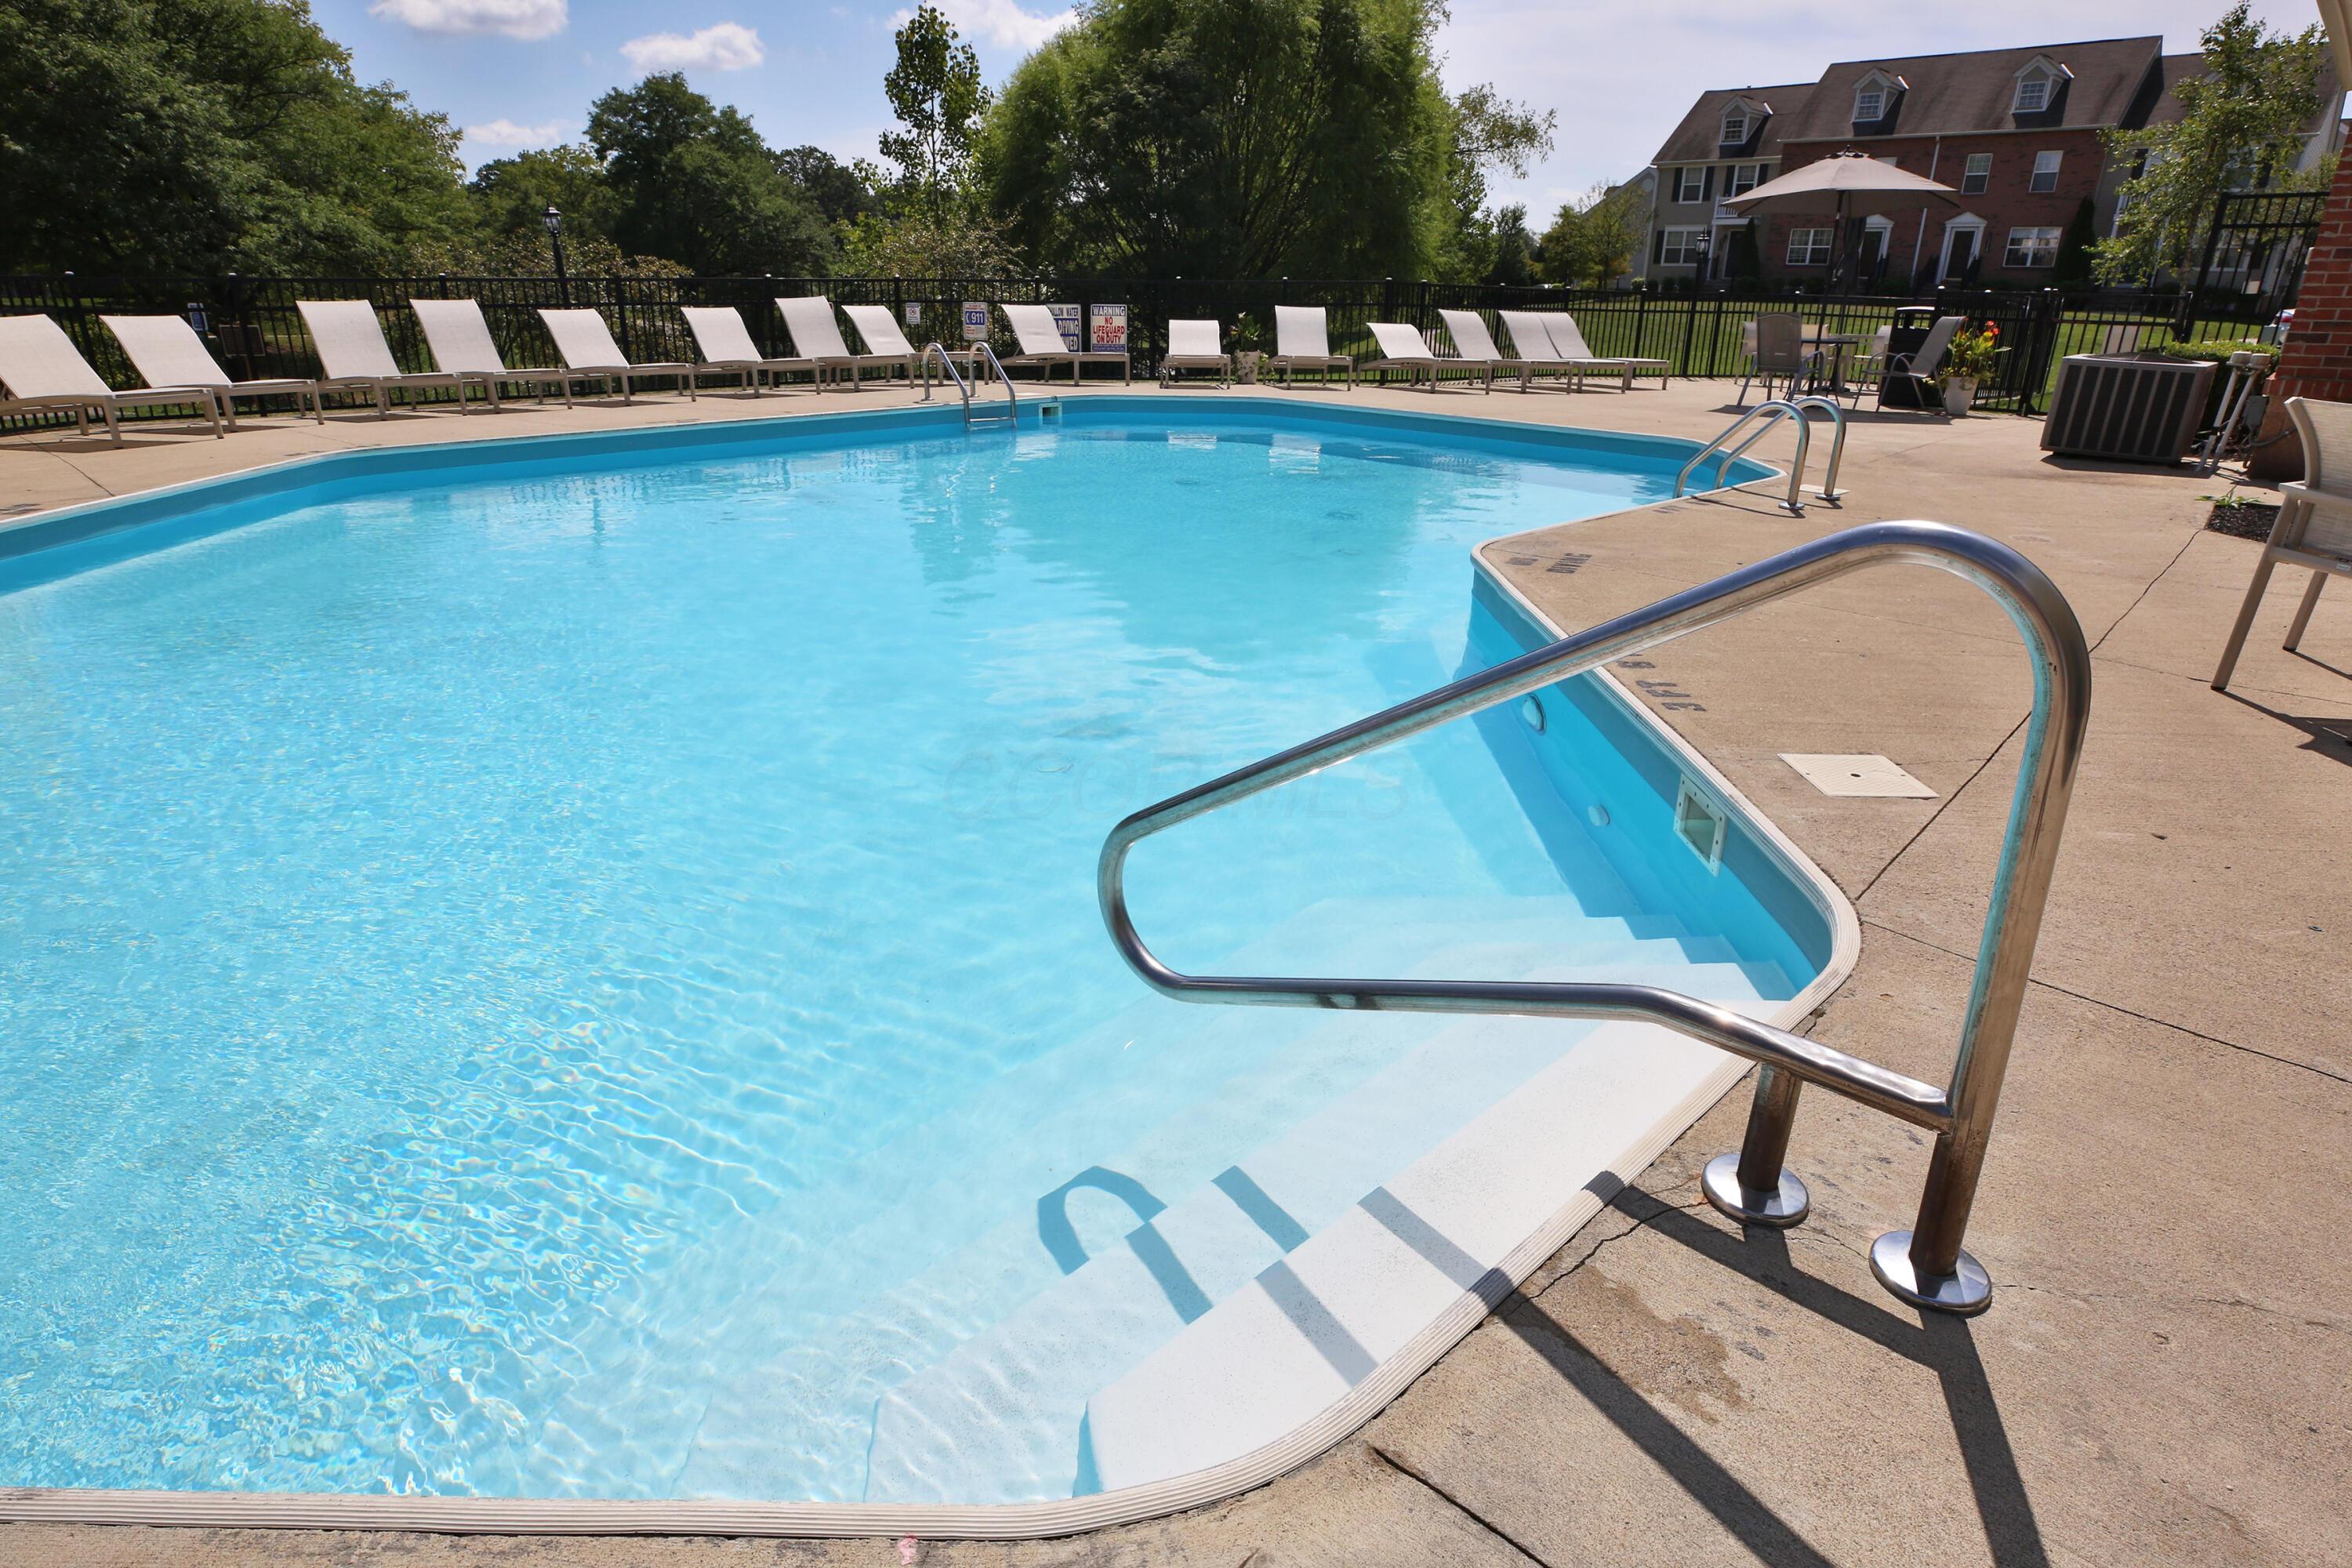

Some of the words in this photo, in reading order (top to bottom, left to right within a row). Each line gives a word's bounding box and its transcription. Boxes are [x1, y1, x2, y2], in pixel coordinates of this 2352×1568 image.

[1066, 307, 1079, 317] WATER
[1092, 306, 1125, 315] WARNING
[971, 312, 984, 324] 911
[1104, 317, 1113, 325] NO
[1058, 320, 1079, 335] DIVING
[1093, 326, 1125, 335] LIFEGUARD
[1096, 335, 1105, 343] ON
[1106, 335, 1122, 343] DUTY
[1062, 336, 1079, 352] WED
